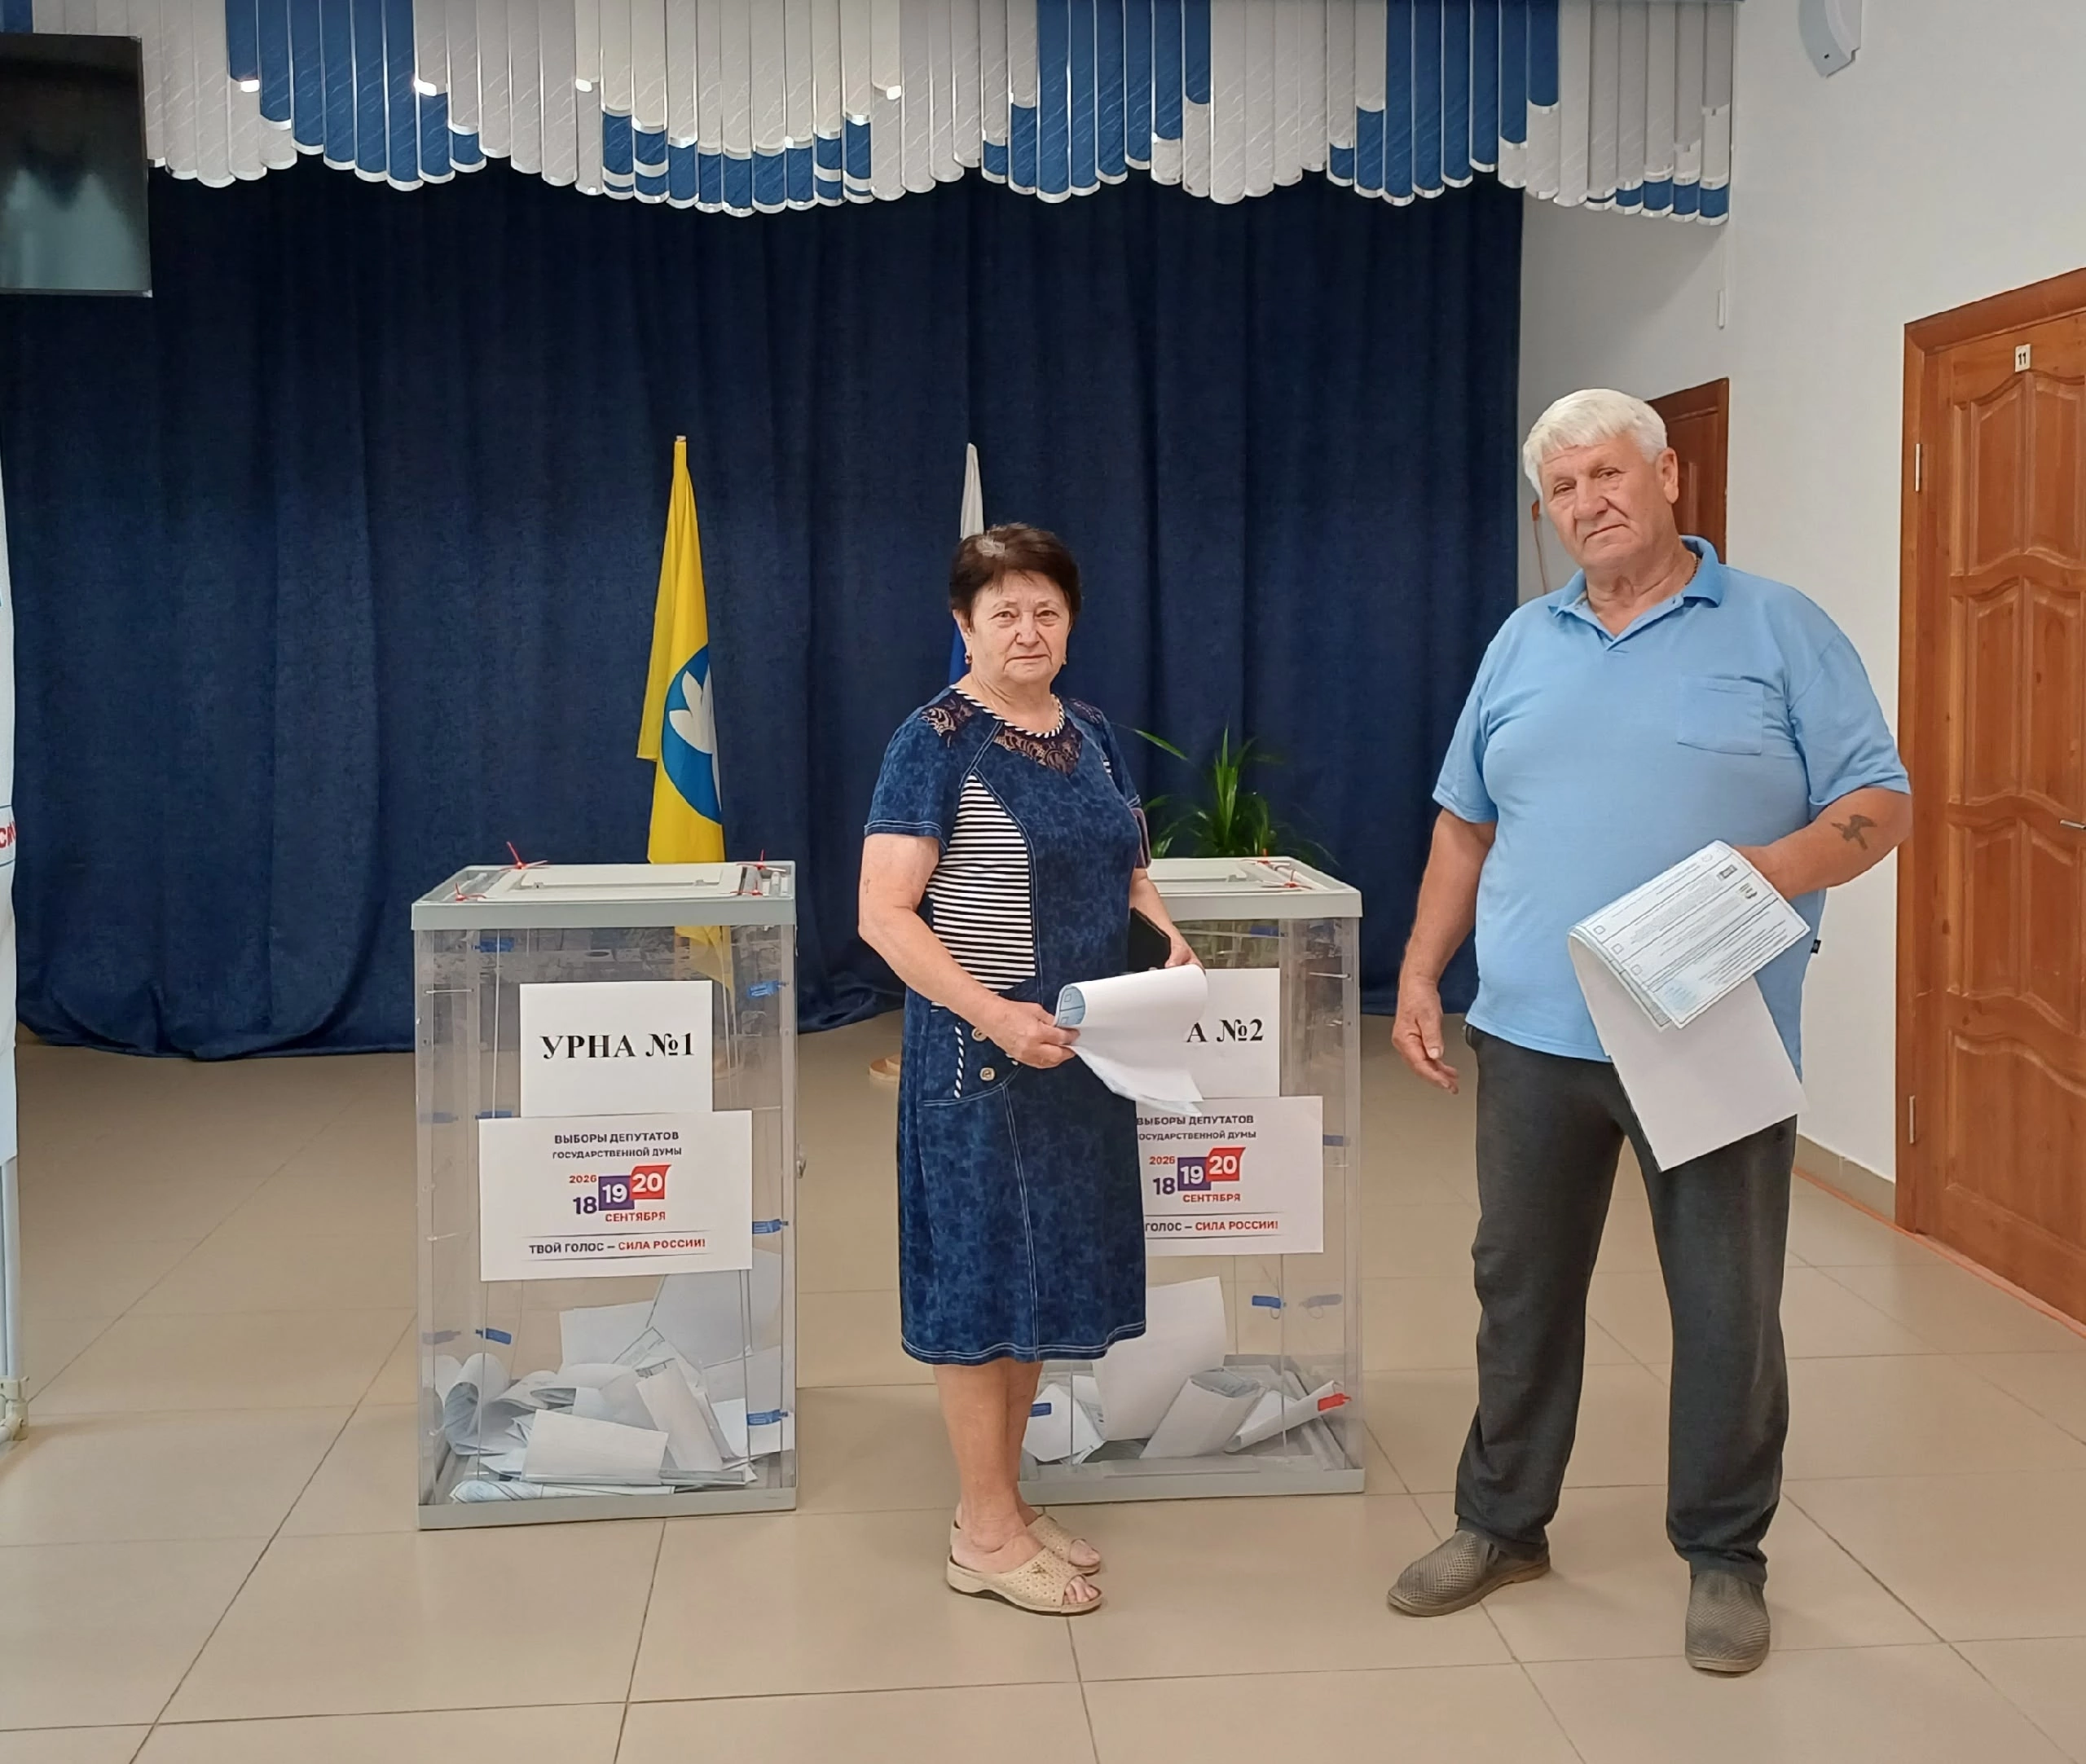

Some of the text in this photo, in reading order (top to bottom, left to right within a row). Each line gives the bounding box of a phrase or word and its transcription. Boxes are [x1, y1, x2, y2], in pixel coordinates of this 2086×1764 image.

[2018, 351, 2027, 366] 11
[1217, 1018, 1264, 1042] №2
[539, 1032, 695, 1059] УРНА №1
[1137, 1115, 1254, 1126] ВЫБОРЫ ДЕПУТАТОВ
[554, 1132, 679, 1144] ВЫБОРЫ ДЕПУТАТОВ
[1138, 1130, 1256, 1141] ОСУДАРСТВЕННОЙ ДУМЫ
[552, 1147, 682, 1159] ГОСУДАРСТВЕННОЙ ДУМЫ
[1149, 1156, 1175, 1165] 2026
[569, 1175, 597, 1183] 2026
[1152, 1155, 1238, 1195] 18 19 20
[573, 1172, 663, 1215] 18 19 20
[1182, 1194, 1241, 1203] СЕНТЯБРЯ
[605, 1211, 666, 1222] СЕНТЯБРЯ
[1145, 1222, 1182, 1232] ГОЛОС
[1195, 1221, 1226, 1231] СИЛА
[1229, 1221, 1278, 1230] РОССИИ!
[529, 1242, 562, 1254] ТВОЙ
[565, 1242, 605, 1253] ГОЛОС
[618, 1240, 650, 1251] СИЛА
[654, 1238, 706, 1249] РОССИИ!
